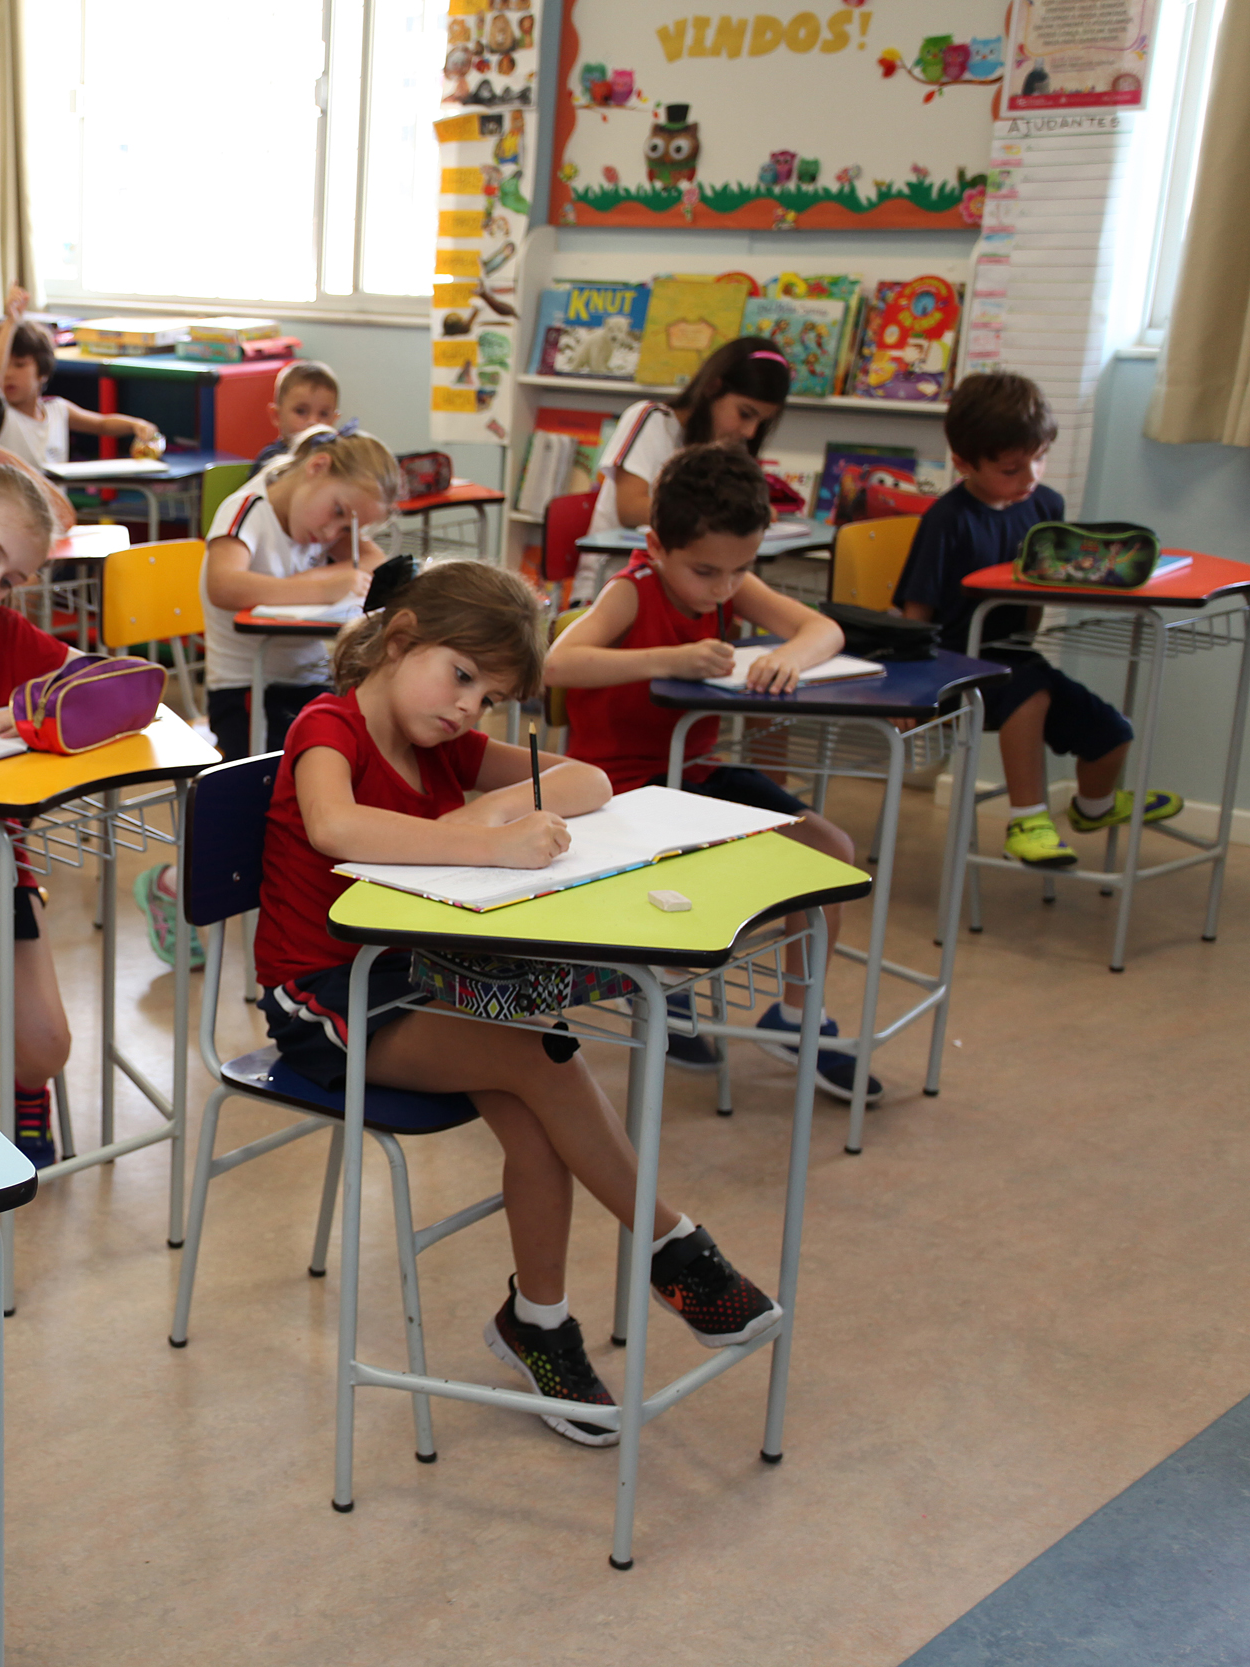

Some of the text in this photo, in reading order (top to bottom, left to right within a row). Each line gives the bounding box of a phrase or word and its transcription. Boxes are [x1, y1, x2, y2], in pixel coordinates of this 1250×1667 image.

[655, 9, 873, 63] VINDOS!
[1007, 115, 1120, 138] AJUDANTES
[567, 288, 637, 322] KNUT
